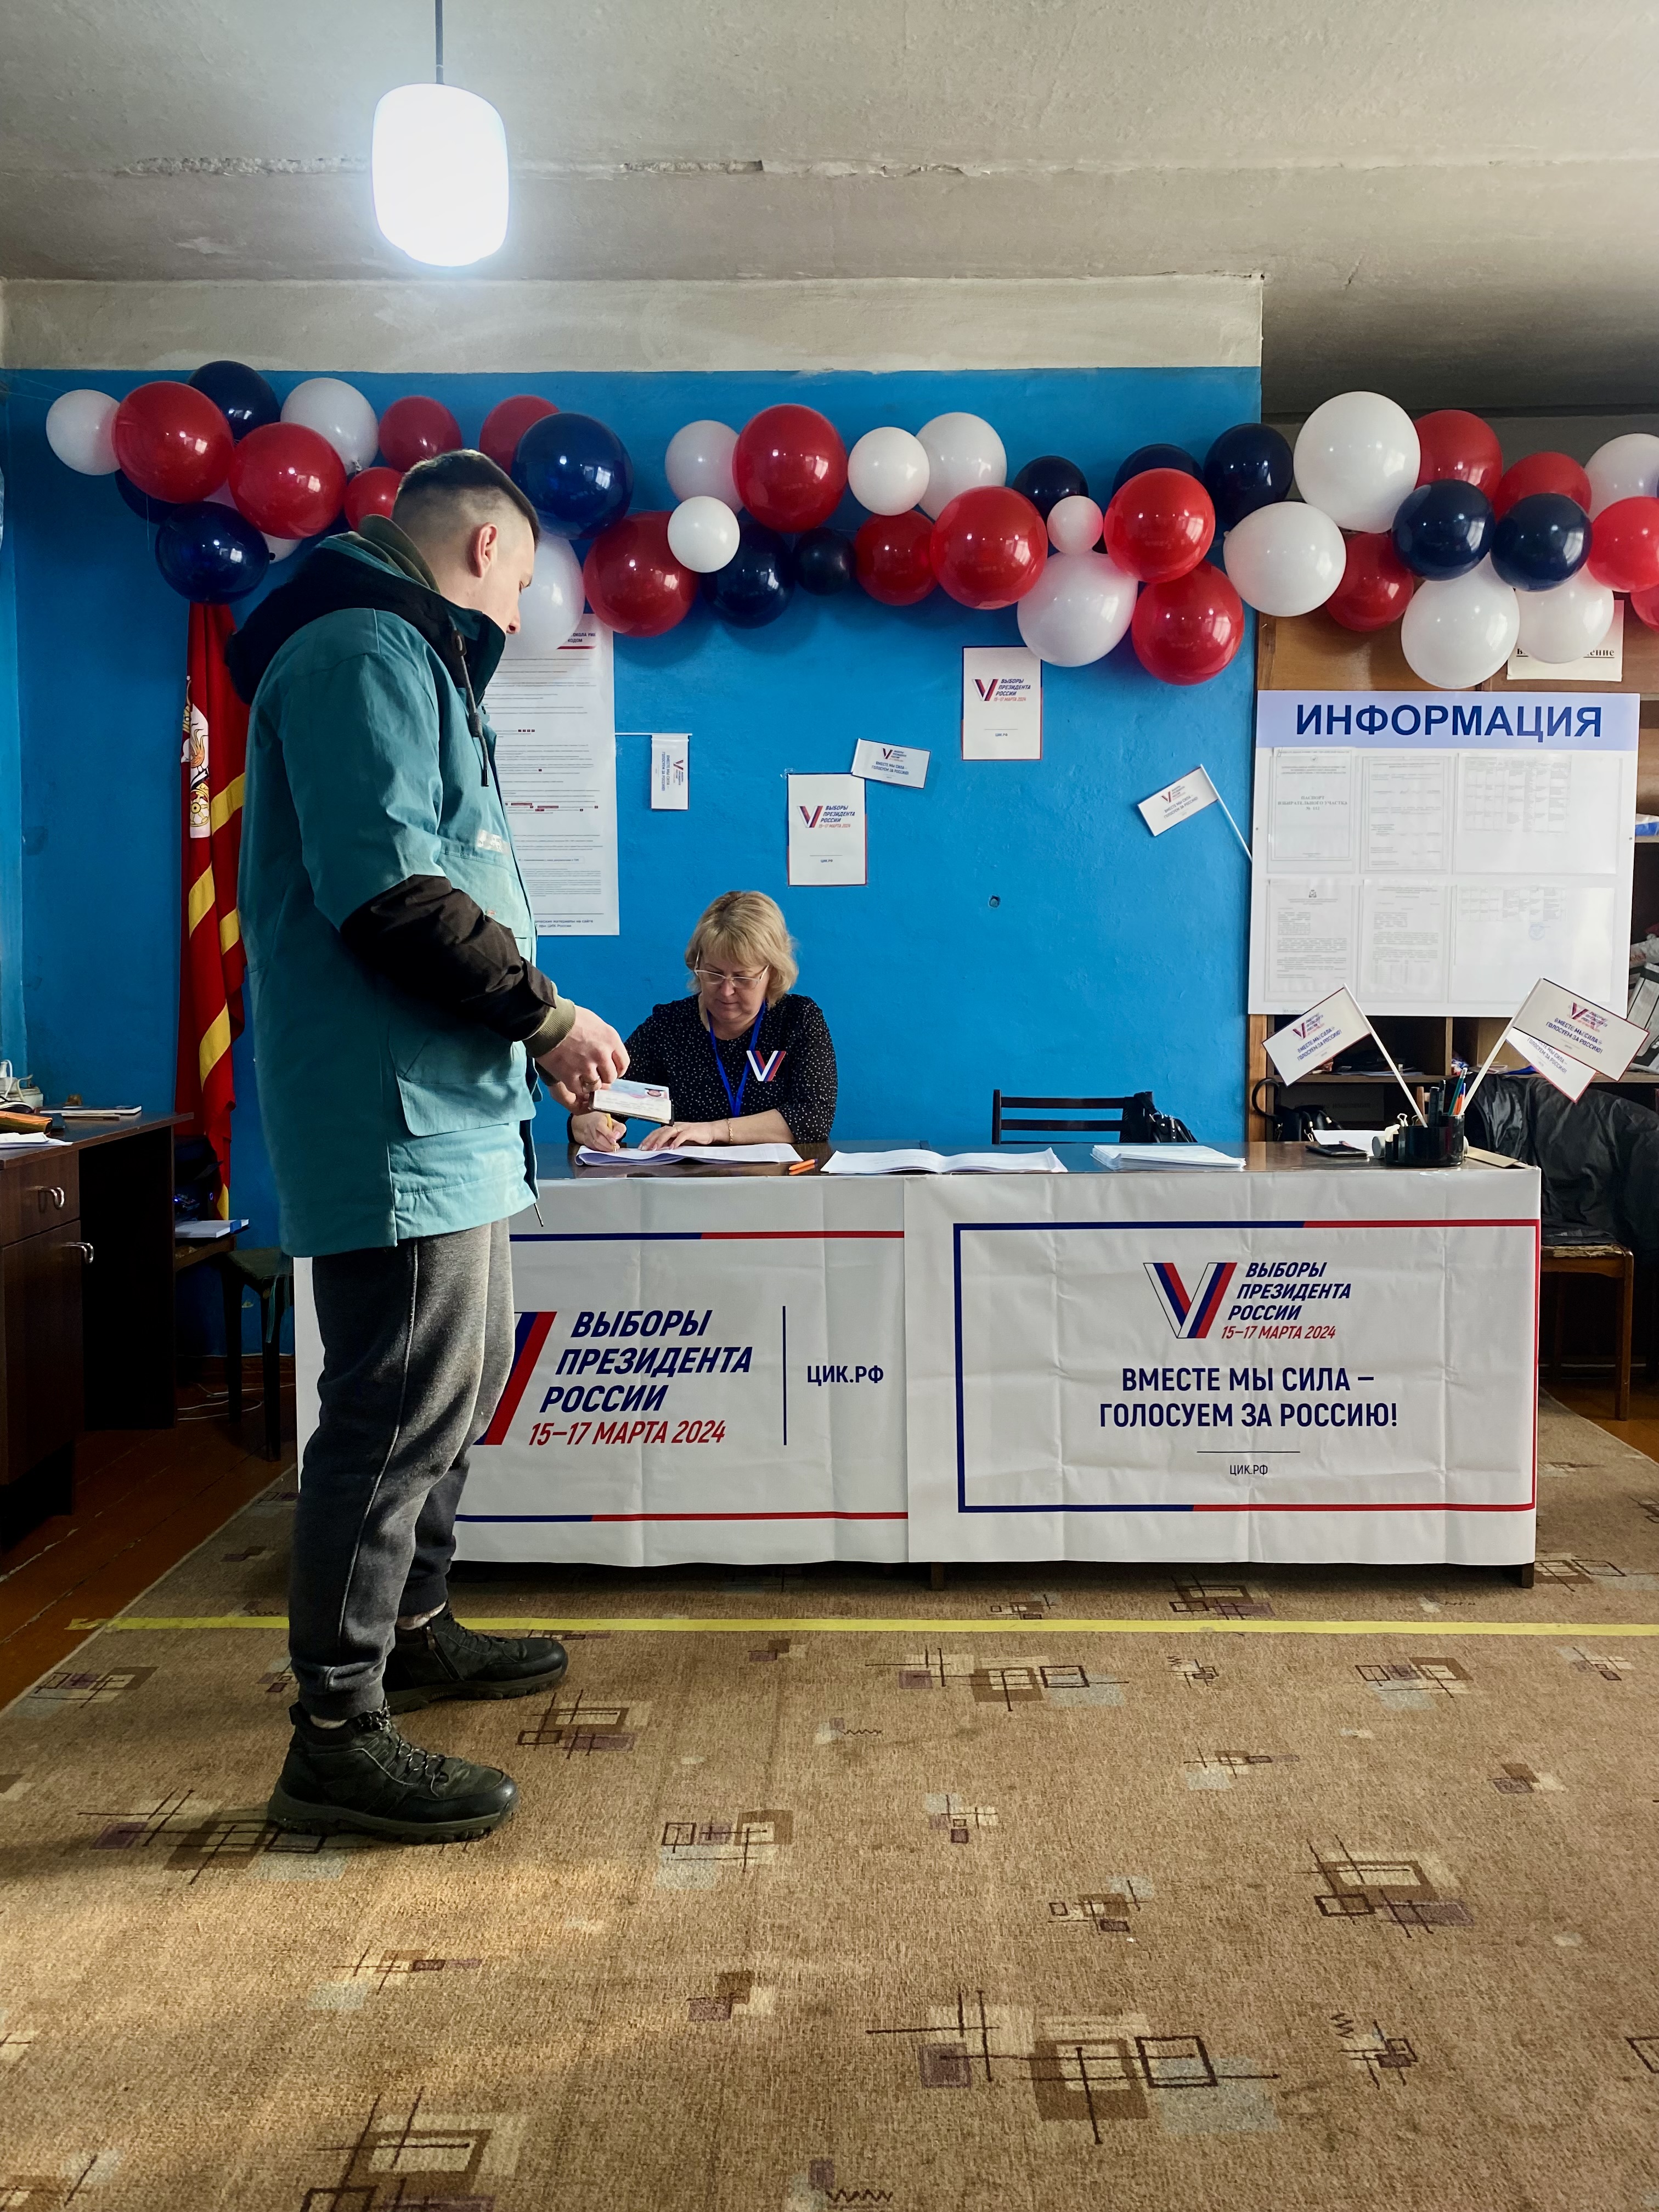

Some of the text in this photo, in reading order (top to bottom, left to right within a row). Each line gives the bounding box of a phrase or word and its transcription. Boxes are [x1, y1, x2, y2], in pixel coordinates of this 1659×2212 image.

[1297, 704, 1601, 743] ИНФОРМАЦИЯ
[1545, 1021, 1572, 1038] ГОЛОСУЕМ
[1554, 1017, 1575, 1031] ВМЕСТЕ
[1584, 1032, 1598, 1043] СИЛА
[1527, 1037, 1545, 1056] ГОЛОСУЕМ
[1554, 1052, 1565, 1063] СИЛА
[1245, 1262, 1327, 1278] ВЫБОРЫ
[1236, 1283, 1351, 1301] ПРЕЗИДЕНТА
[571, 1310, 713, 1338] ВЫБОРЫ
[1227, 1305, 1302, 1321] РОССИИ
[1261, 1325, 1302, 1339] МАРТА
[1304, 1325, 1336, 1339] 2024
[555, 1346, 753, 1378] ПРЕЗИДЕНТА
[807, 1365, 884, 1387] ЦИК.РФ
[1122, 1367, 1220, 1391] ВМЕСТЕ
[1229, 1367, 1273, 1391] МЫ
[1282, 1367, 1351, 1391] СИЛА
[539, 1385, 669, 1413] РОССИИ
[1100, 1403, 1397, 1427] ГОЛОСУЕМ ЗА РОССИЮ!
[592, 1420, 668, 1444] МАРТА
[671, 1420, 726, 1443] 2024
[1229, 1464, 1268, 1476] ЦИК.РФ
